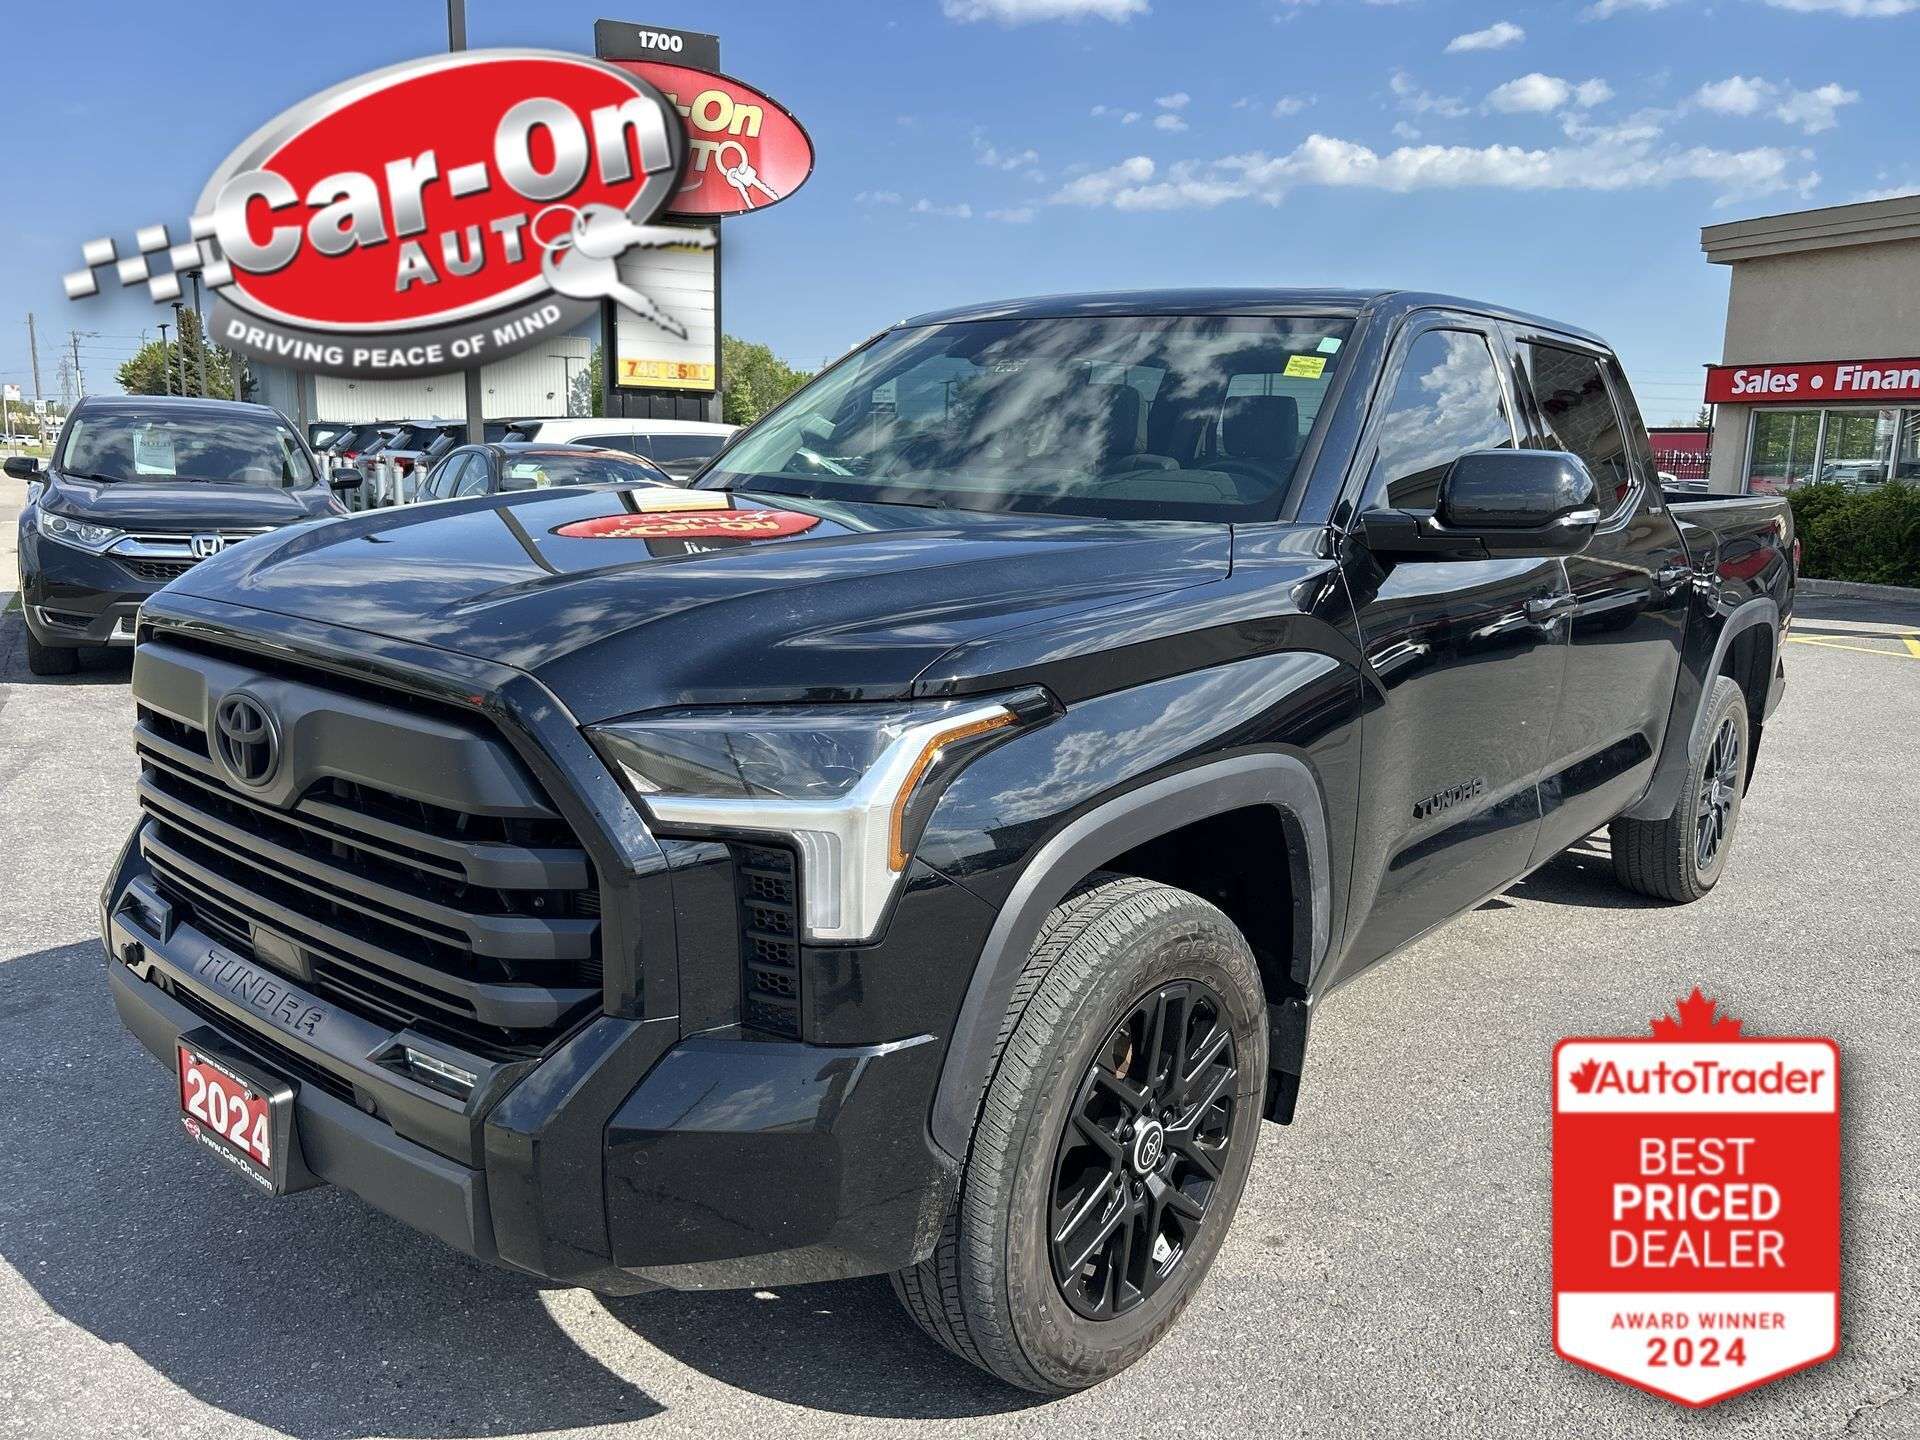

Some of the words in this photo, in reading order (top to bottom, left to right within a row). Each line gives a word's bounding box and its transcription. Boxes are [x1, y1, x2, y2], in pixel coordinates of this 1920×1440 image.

[638, 30, 683, 52] 1700
[1731, 369, 1799, 395] Sales
[1413, 776, 1487, 819] TUNDRA
[201, 949, 324, 1036] TUNDRA
[186, 1067, 271, 1167] 2024
[201, 1133, 273, 1191] www.Car-On.com
